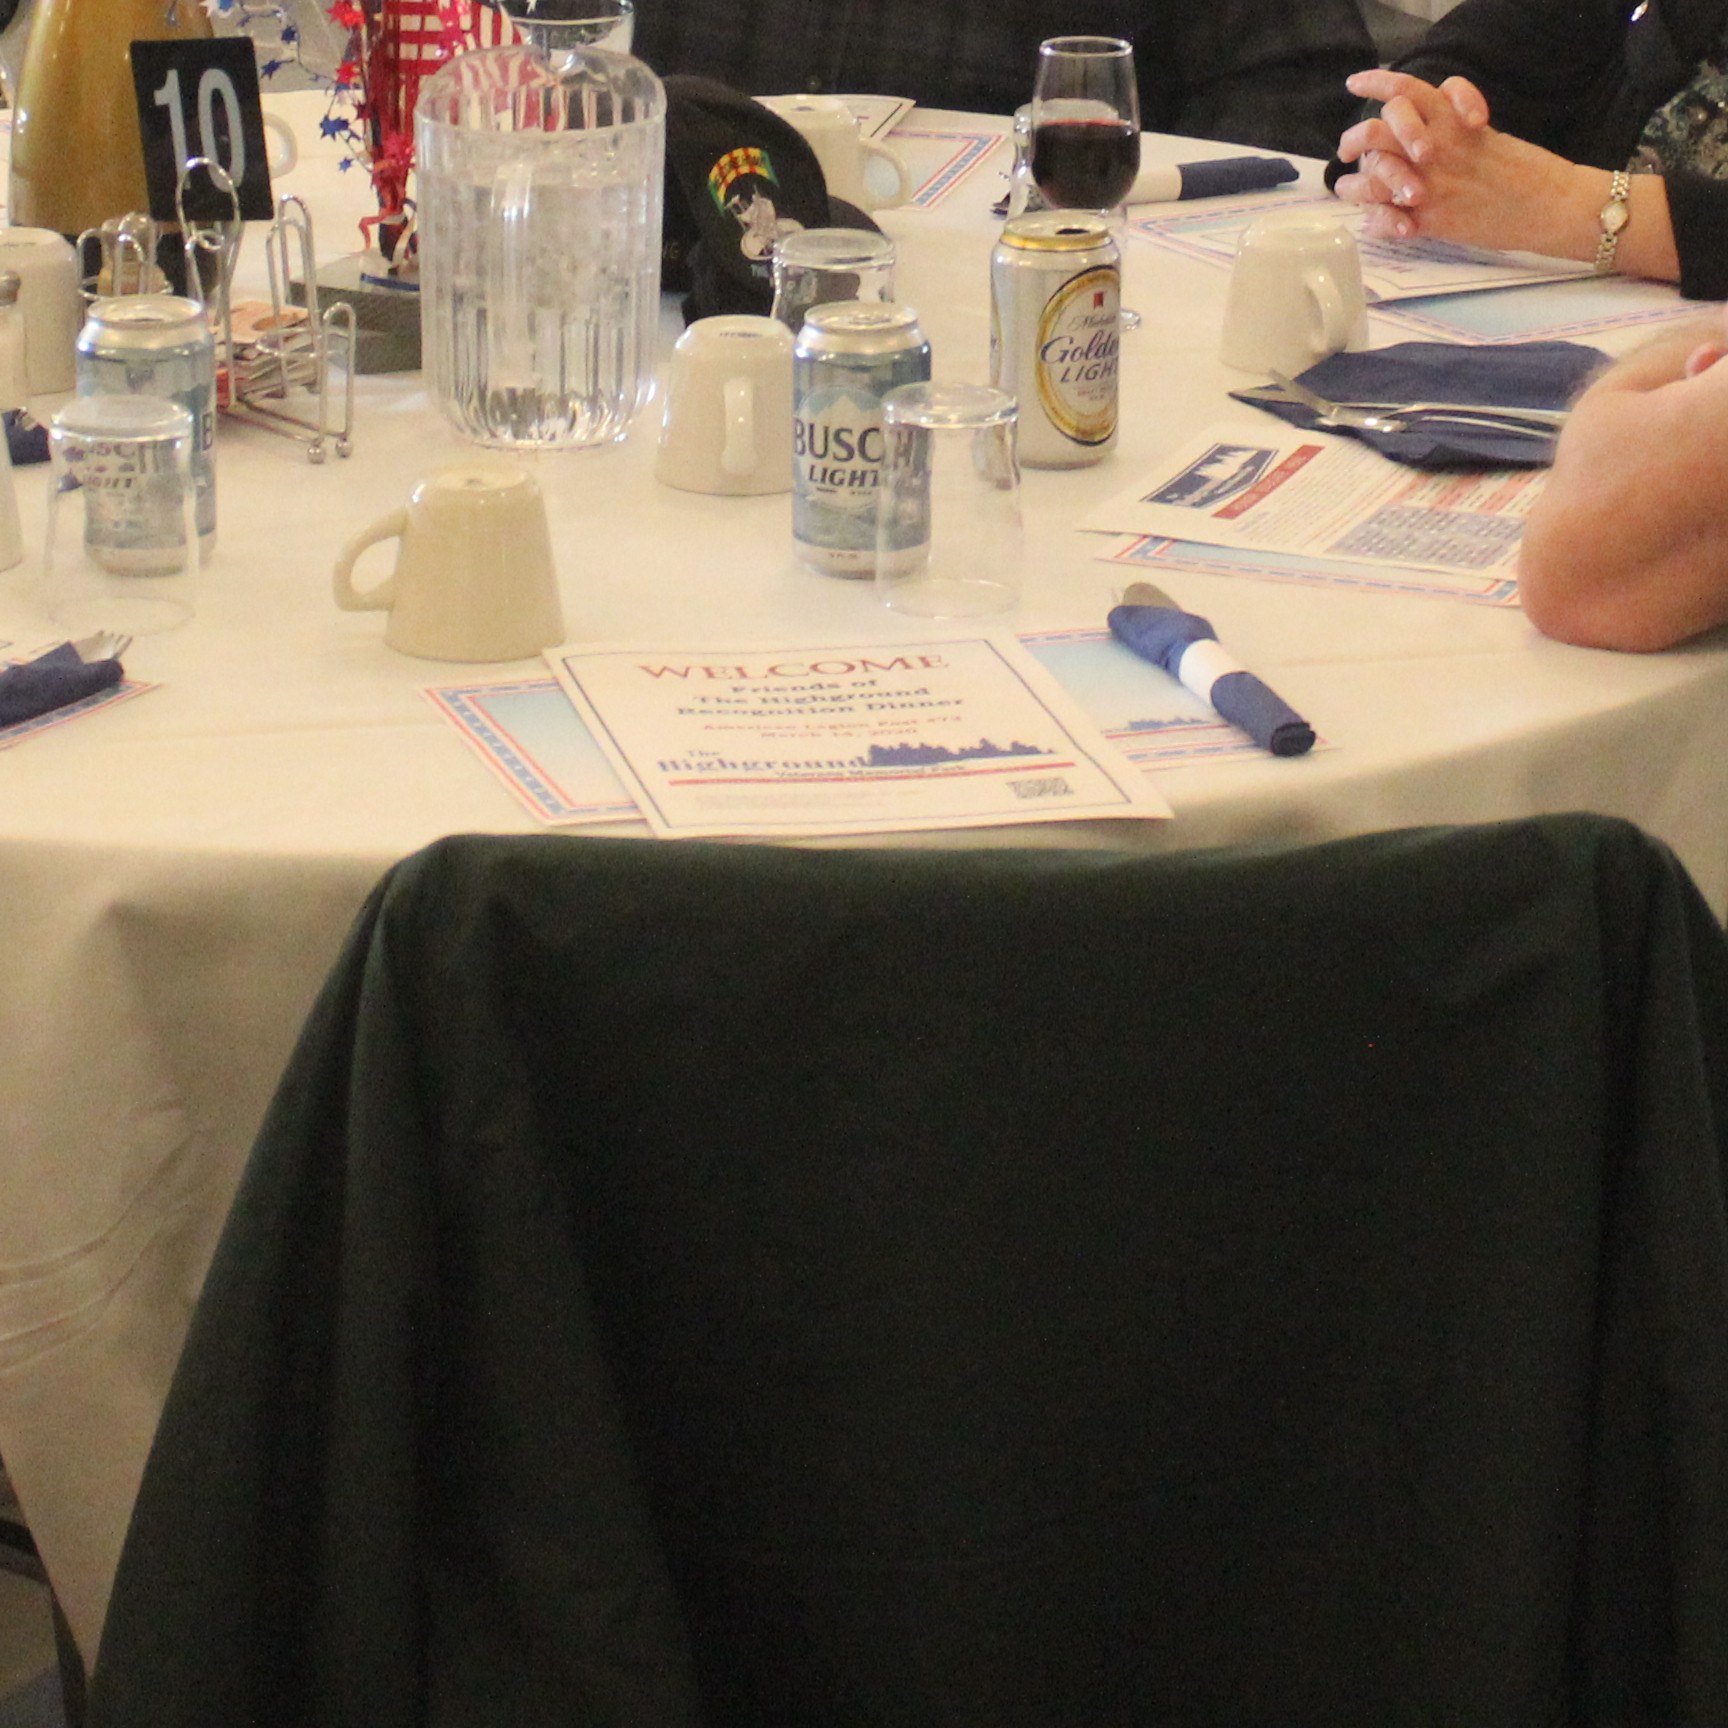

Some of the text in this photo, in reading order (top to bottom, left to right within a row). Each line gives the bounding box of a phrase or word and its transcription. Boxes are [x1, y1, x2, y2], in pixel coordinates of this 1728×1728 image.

[153, 68, 245, 194] 10
[1040, 329, 1119, 364] Golde
[640, 655, 950, 679] WELCOME
[731, 679, 878, 694] Friends of
[694, 687, 931, 705] The Highground
[677, 699, 964, 717] Recognition Dinner
[657, 755, 873, 772] Highground
